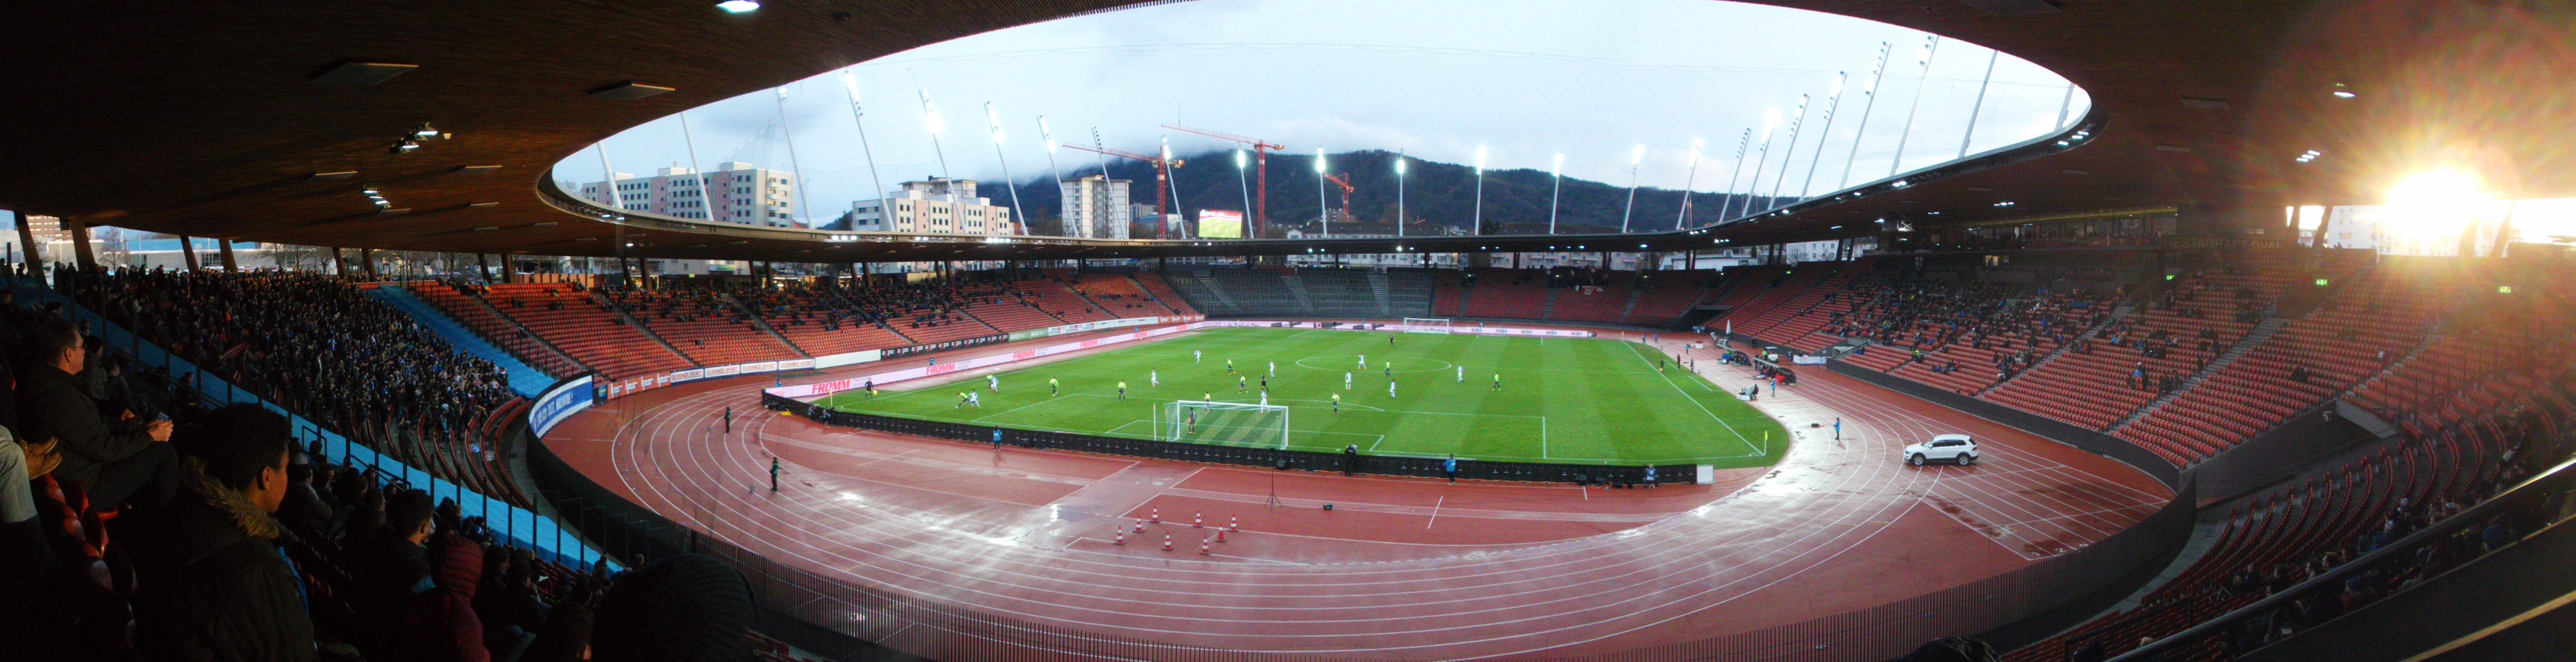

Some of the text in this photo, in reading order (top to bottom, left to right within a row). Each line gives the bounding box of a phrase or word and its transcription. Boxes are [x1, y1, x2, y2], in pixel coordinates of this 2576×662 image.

[2164, 237, 2247, 250] RESTAURANT
[1013, 349, 1035, 359] FROMM
[926, 362, 955, 375] FROMM
[812, 379, 850, 394] FROMM
